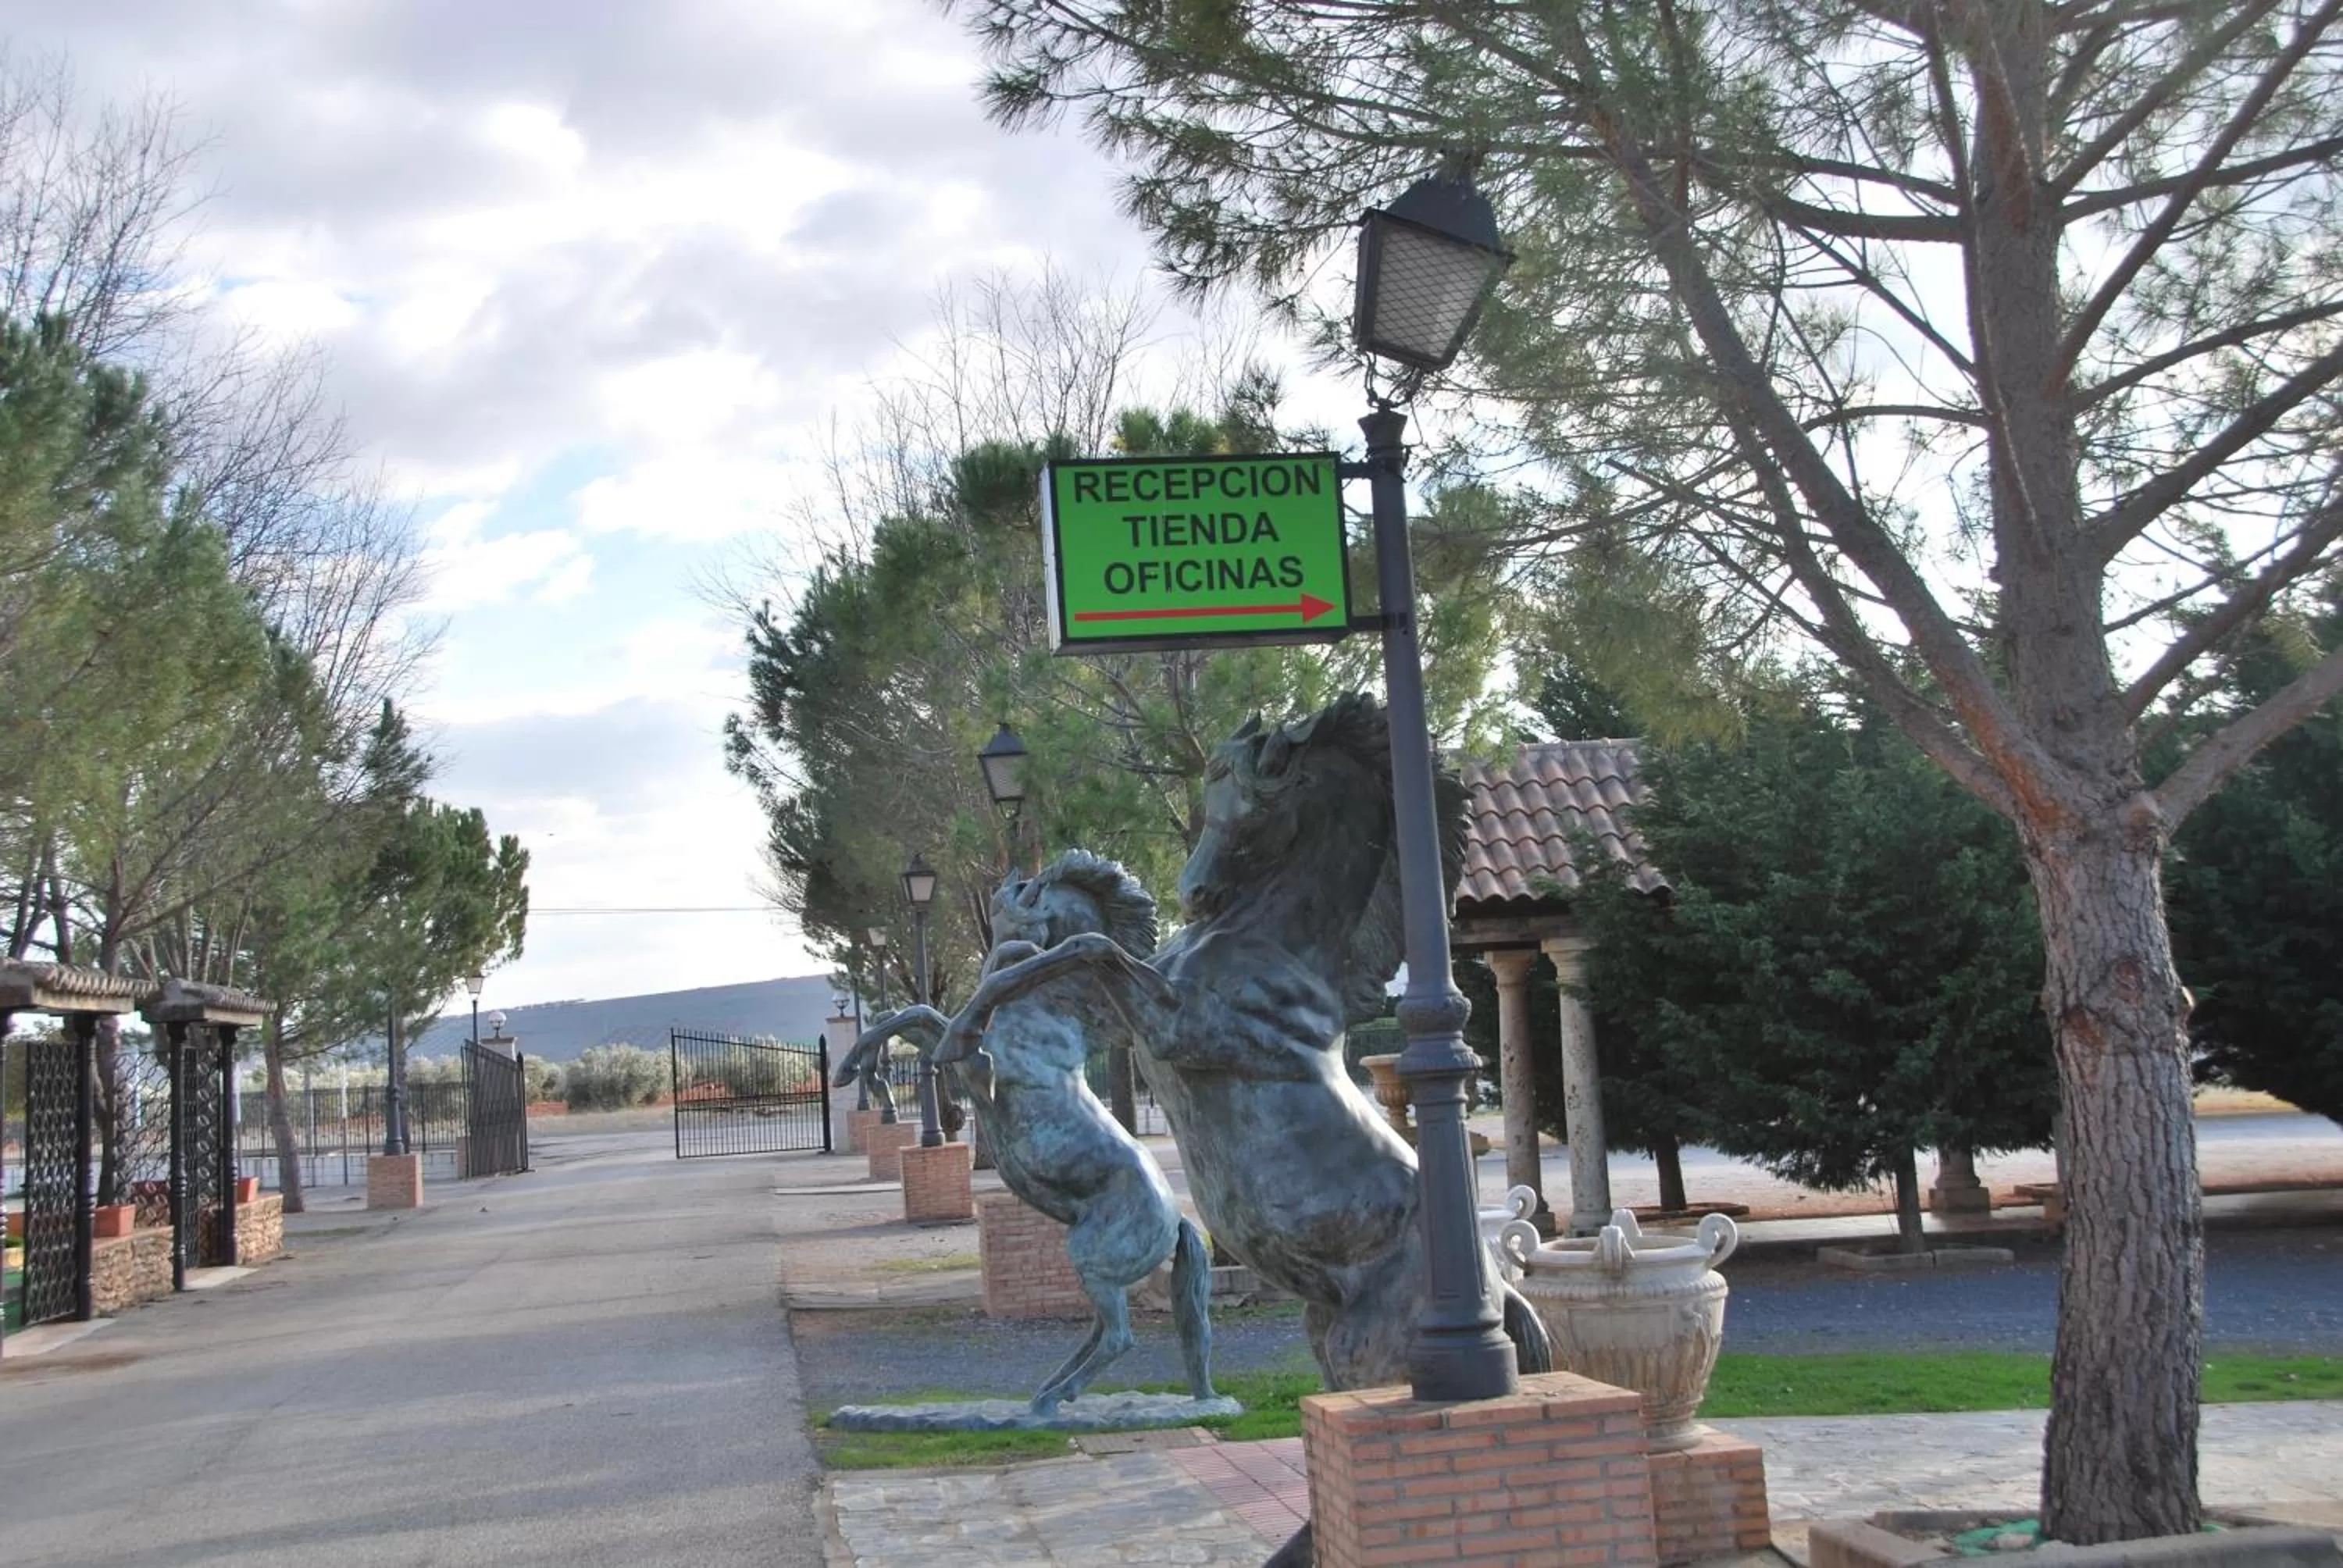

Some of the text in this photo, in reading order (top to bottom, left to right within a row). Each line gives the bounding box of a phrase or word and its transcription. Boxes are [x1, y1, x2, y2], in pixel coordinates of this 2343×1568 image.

[1074, 462, 1321, 504] RECEPCION
[1122, 511, 1279, 547] TIENDA
[1104, 555, 1304, 595] OFICINAS
